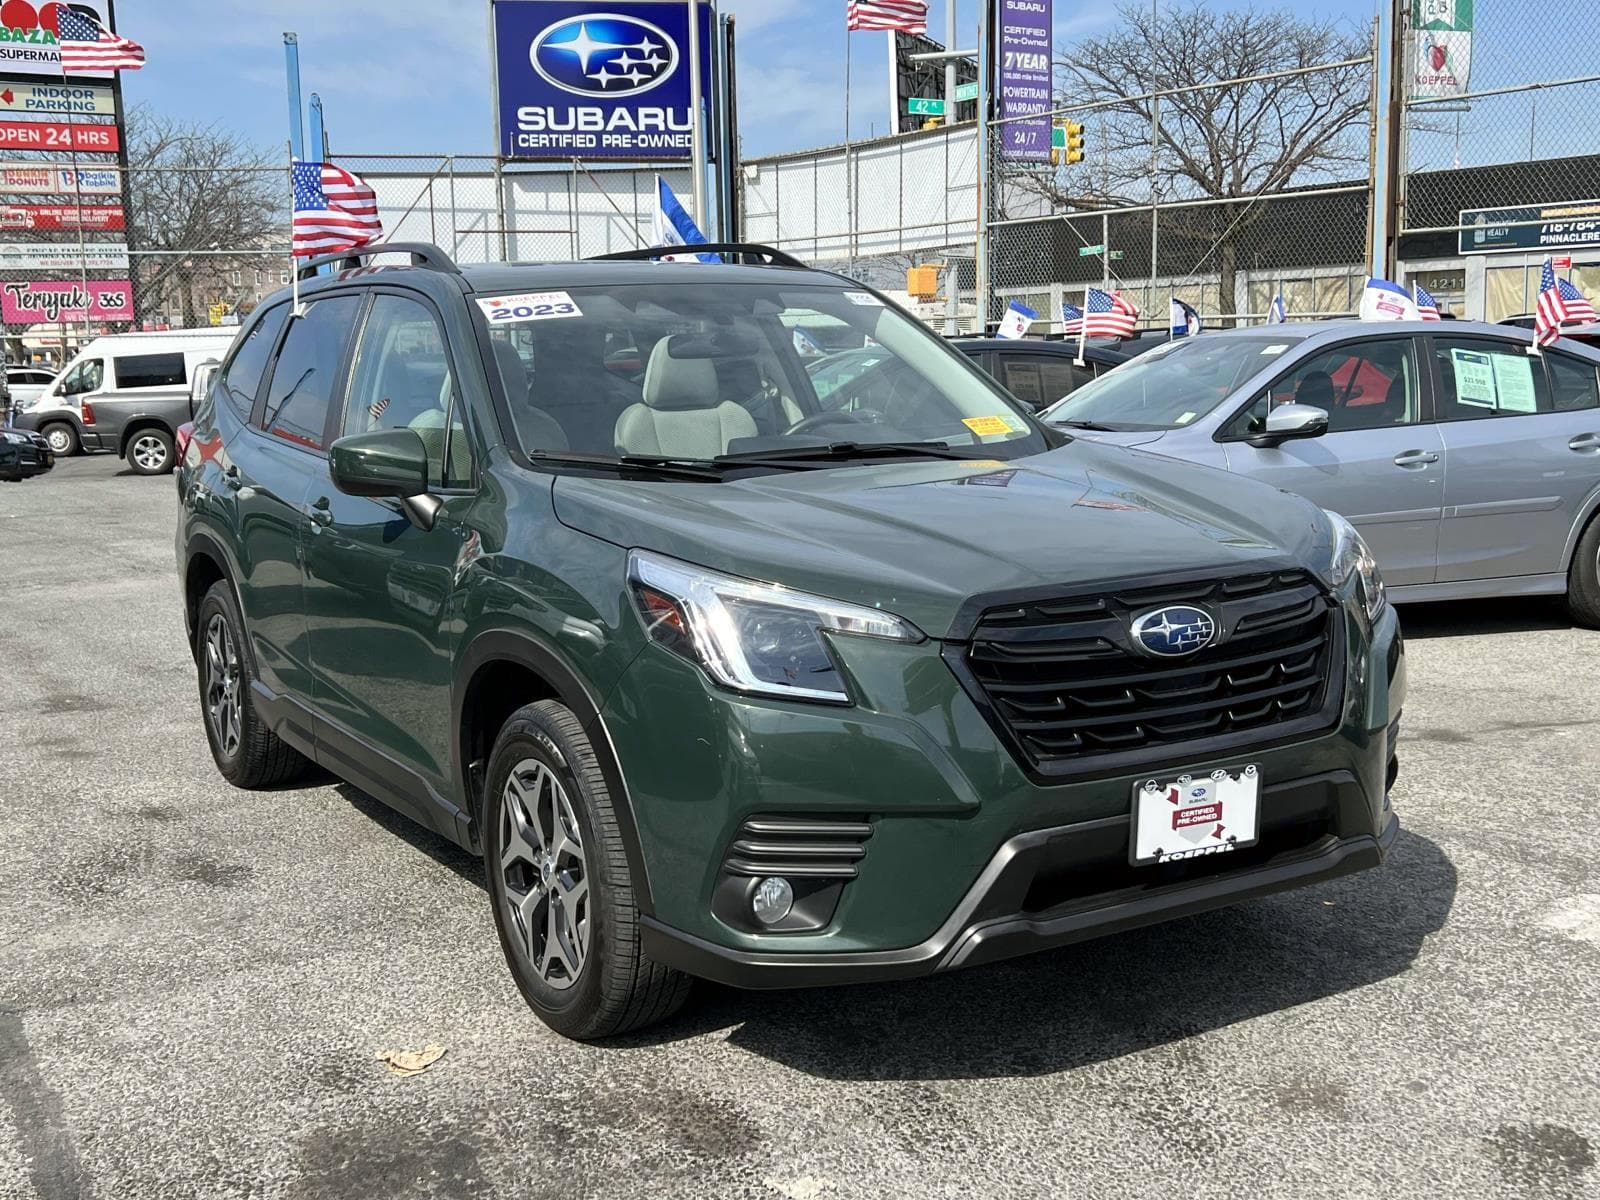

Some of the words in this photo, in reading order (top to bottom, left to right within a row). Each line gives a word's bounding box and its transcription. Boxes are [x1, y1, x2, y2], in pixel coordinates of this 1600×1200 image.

[1006, 1, 1046, 13] SUBARU
[0, 27, 60, 45] BAZA
[1004, 25, 1046, 37] CERTIFIED
[1003, 36, 1048, 47] Pre-Owned
[1005, 52, 1015, 69] 7
[1016, 52, 1048, 71] YEAR
[1414, 74, 1458, 86] KOEPPEL
[32, 87, 95, 99] INDOOR
[1003, 86, 1048, 99] POWERTRAIN
[25, 99, 96, 111] PARKING
[915, 101, 928, 113] 42
[1005, 102, 1047, 114] WARRANTY
[517, 106, 693, 131] SUBARU
[45, 128, 72, 145] 24
[77, 131, 110, 145] HRS
[518, 134, 597, 148] CERTIFIED
[602, 134, 693, 148] PRE-OWNED
[9, 178, 49, 186] DONUTS
[1429, 278, 1465, 289] 4211
[99, 293, 125, 308] 365
[491, 303, 575, 320] 2023
[1181, 807, 1214, 817] CERTIFIED
[1177, 813, 1217, 825] PRE-OWNED
[1158, 843, 1235, 863] KOEPPEL
